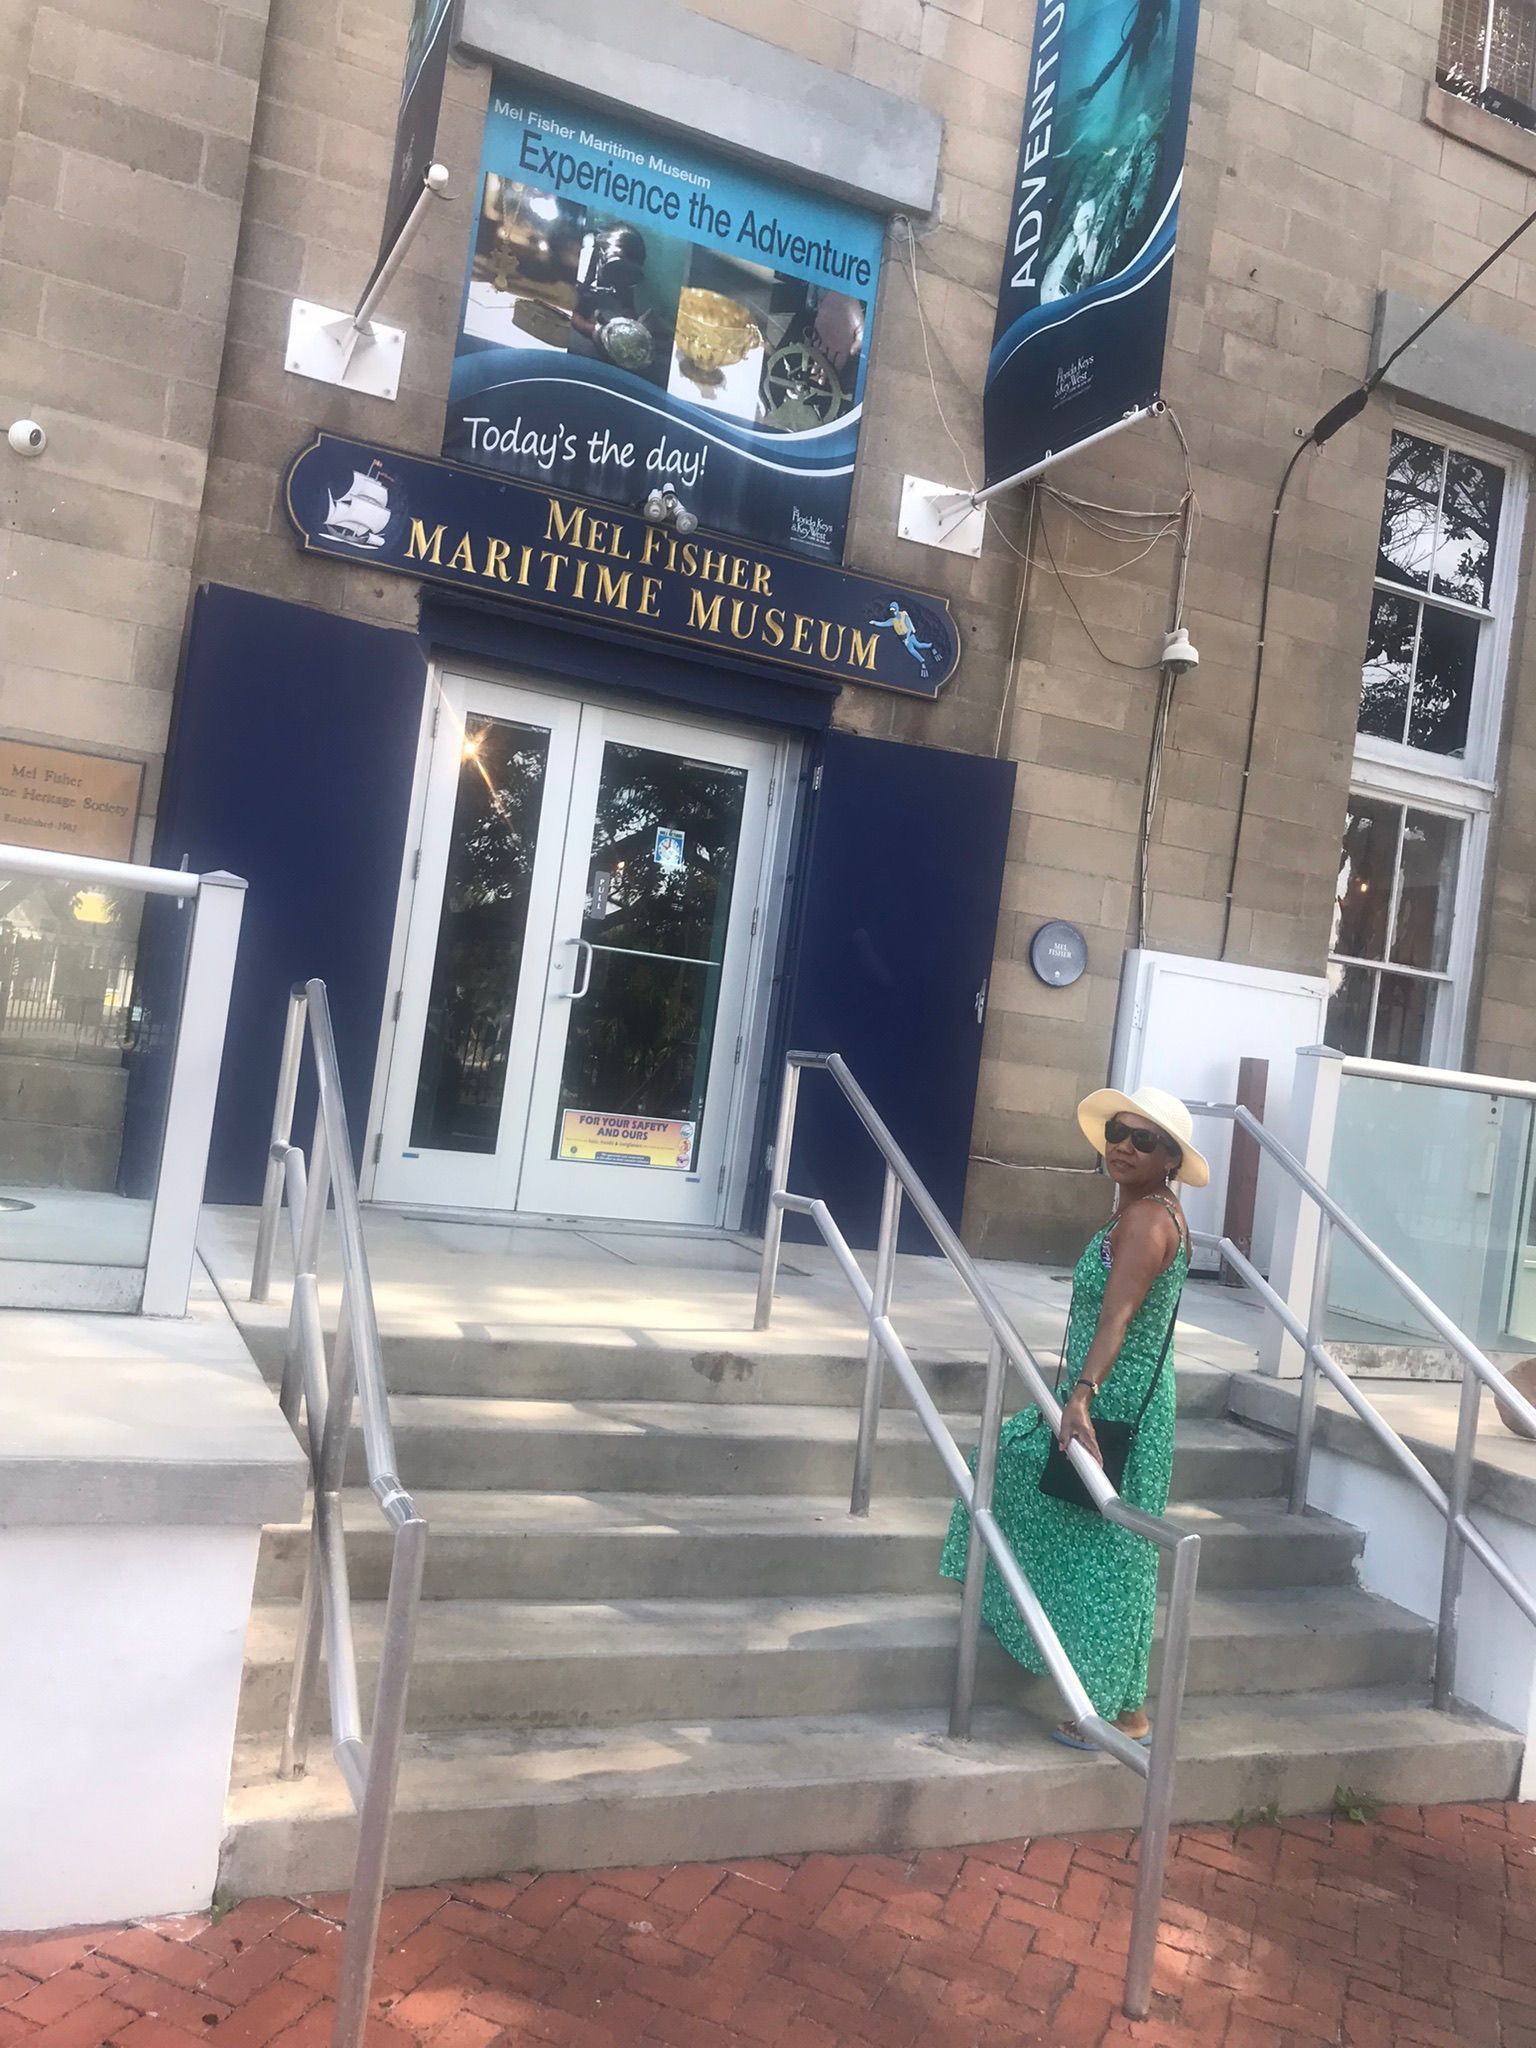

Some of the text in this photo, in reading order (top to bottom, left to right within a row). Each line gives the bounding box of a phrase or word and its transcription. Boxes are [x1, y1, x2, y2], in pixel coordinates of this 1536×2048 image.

[494, 98, 711, 190] Mel Fisher Maritime Museum
[1010, 0, 1066, 288] ADVENTU
[518, 129, 872, 287] Experience the Adventure
[462, 416, 709, 487] Today's the day!
[543, 498, 774, 597] MEL FISHER
[403, 516, 881, 671] MARITIME MUSEUM
[11, 763, 83, 788] Mel Fisher
[22, 787, 77, 808] Heritage
[82, 797, 129, 817] Society
[596, 878, 605, 910] PULL
[1048, 948, 1071, 959] FISHER
[1054, 942, 1067, 951] MEL
[579, 1115, 669, 1133] FOR YOUR SAFETY
[596, 1127, 649, 1141] AND OURS
